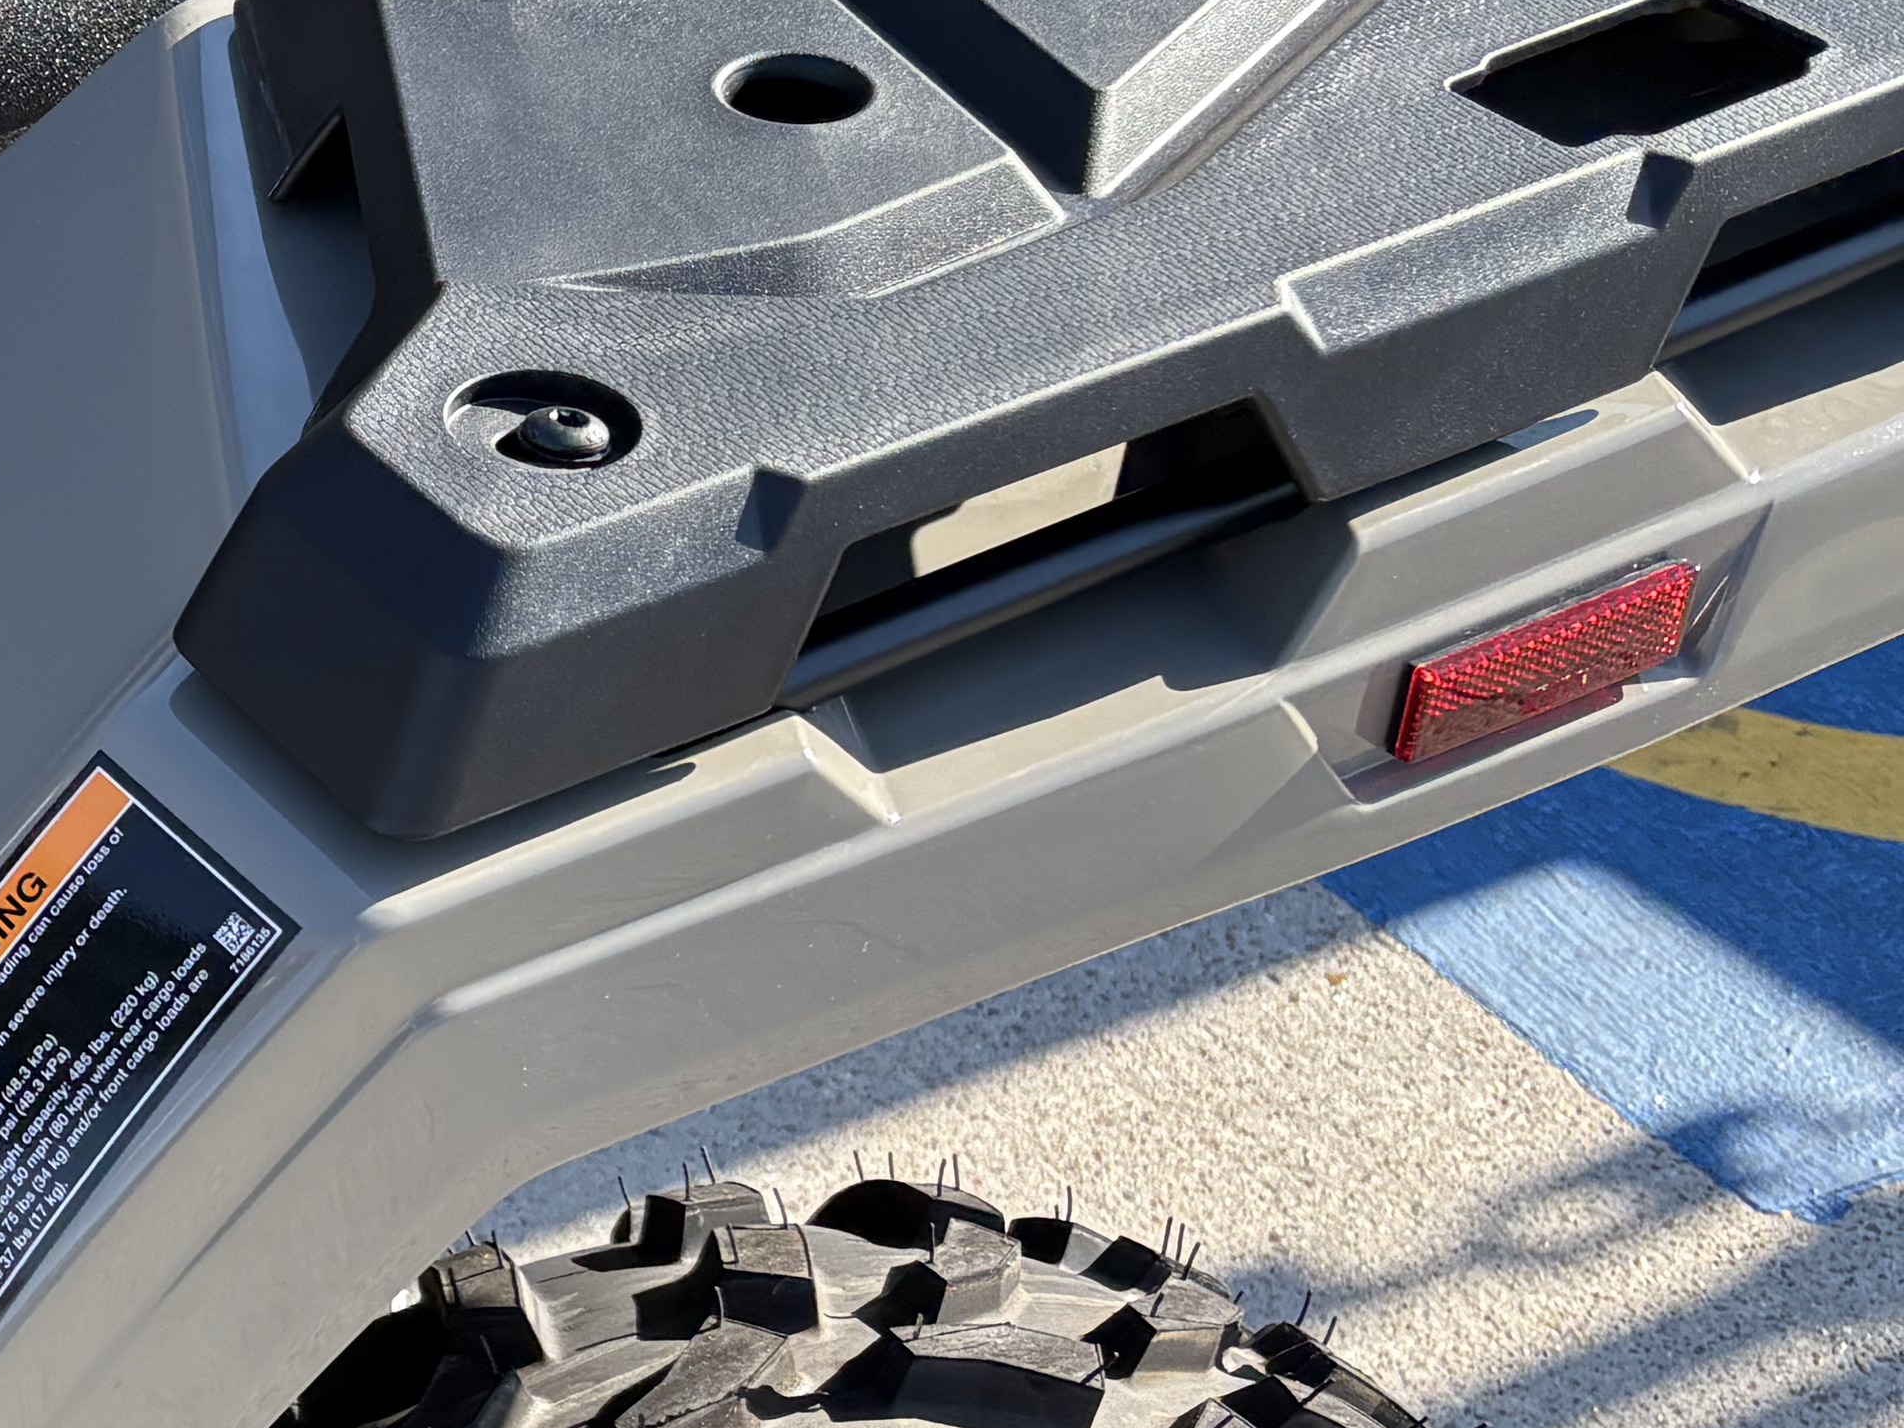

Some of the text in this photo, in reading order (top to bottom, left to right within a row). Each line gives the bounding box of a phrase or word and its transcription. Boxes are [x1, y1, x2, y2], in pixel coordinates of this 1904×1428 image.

[28, 916, 52, 943] can
[50, 875, 85, 916] cause
[82, 845, 111, 875] loss
[109, 826, 124, 845] of
[8, 985, 46, 1031] severe
[42, 945, 77, 985] injury
[75, 928, 90, 947] or
[89, 889, 128, 930] death.
[1, 1065, 31, 1104] (48.3
[26, 1033, 58, 1068] kPa)
[1, 1210, 19, 1232] 75
[14, 1191, 36, 1214] lbs
[31, 1167, 52, 1193] (34
[47, 1145, 70, 1170] kg)
[66, 1101, 102, 1148] and/or
[98, 1068, 129, 1103] front
[126, 1030, 159, 1070] cargo
[155, 992, 190, 1031] loads
[188, 969, 209, 994] are
[11, 1166, 29, 1187] 50
[26, 1137, 53, 1169] mph
[48, 1113, 69, 1139] (80
[64, 1083, 94, 1116] kph)
[90, 1047, 122, 1084] when
[119, 1018, 143, 1048] rear
[142, 980, 176, 1020] cargo
[171, 942, 207, 981] loads
[14, 1078, 45, 1117] (48.3
[40, 1046, 71, 1081] kPa)
[21, 1081, 71, 1144] capacity:
[69, 1052, 92, 1081] 485
[87, 1031, 114, 1055] lbs.
[110, 994, 138, 1029] (220
[134, 971, 159, 996] kg)
[0, 1246, 15, 1269] 37
[12, 1227, 33, 1251] lbs
[28, 1203, 47, 1230] (17
[43, 1181, 69, 1207] kg).
